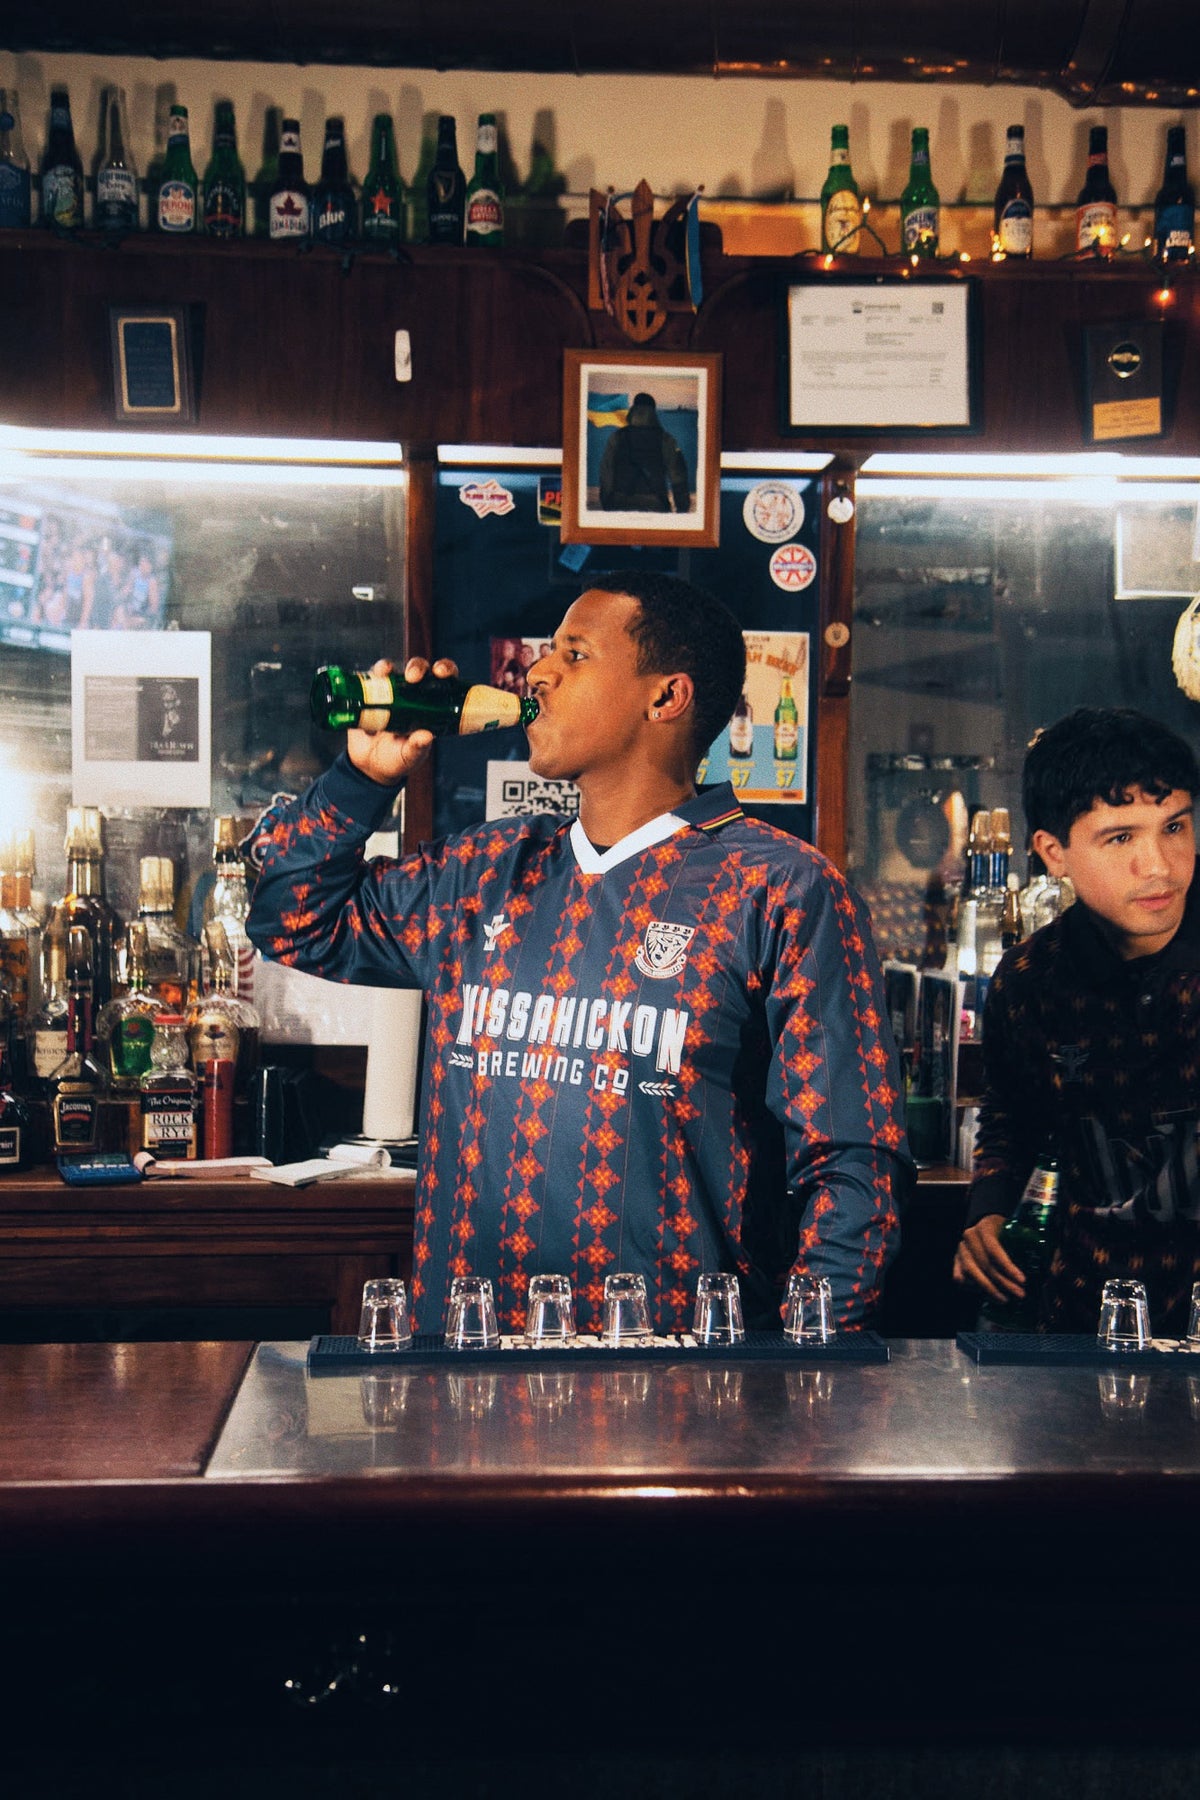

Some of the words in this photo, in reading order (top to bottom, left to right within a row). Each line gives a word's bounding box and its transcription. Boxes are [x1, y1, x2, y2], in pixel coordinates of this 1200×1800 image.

[319, 210, 346, 229] Blue
[731, 768, 750, 788] $7
[777, 769, 795, 788] $7
[477, 1051, 584, 1085] BREWING
[152, 1112, 190, 1124] ROCK
